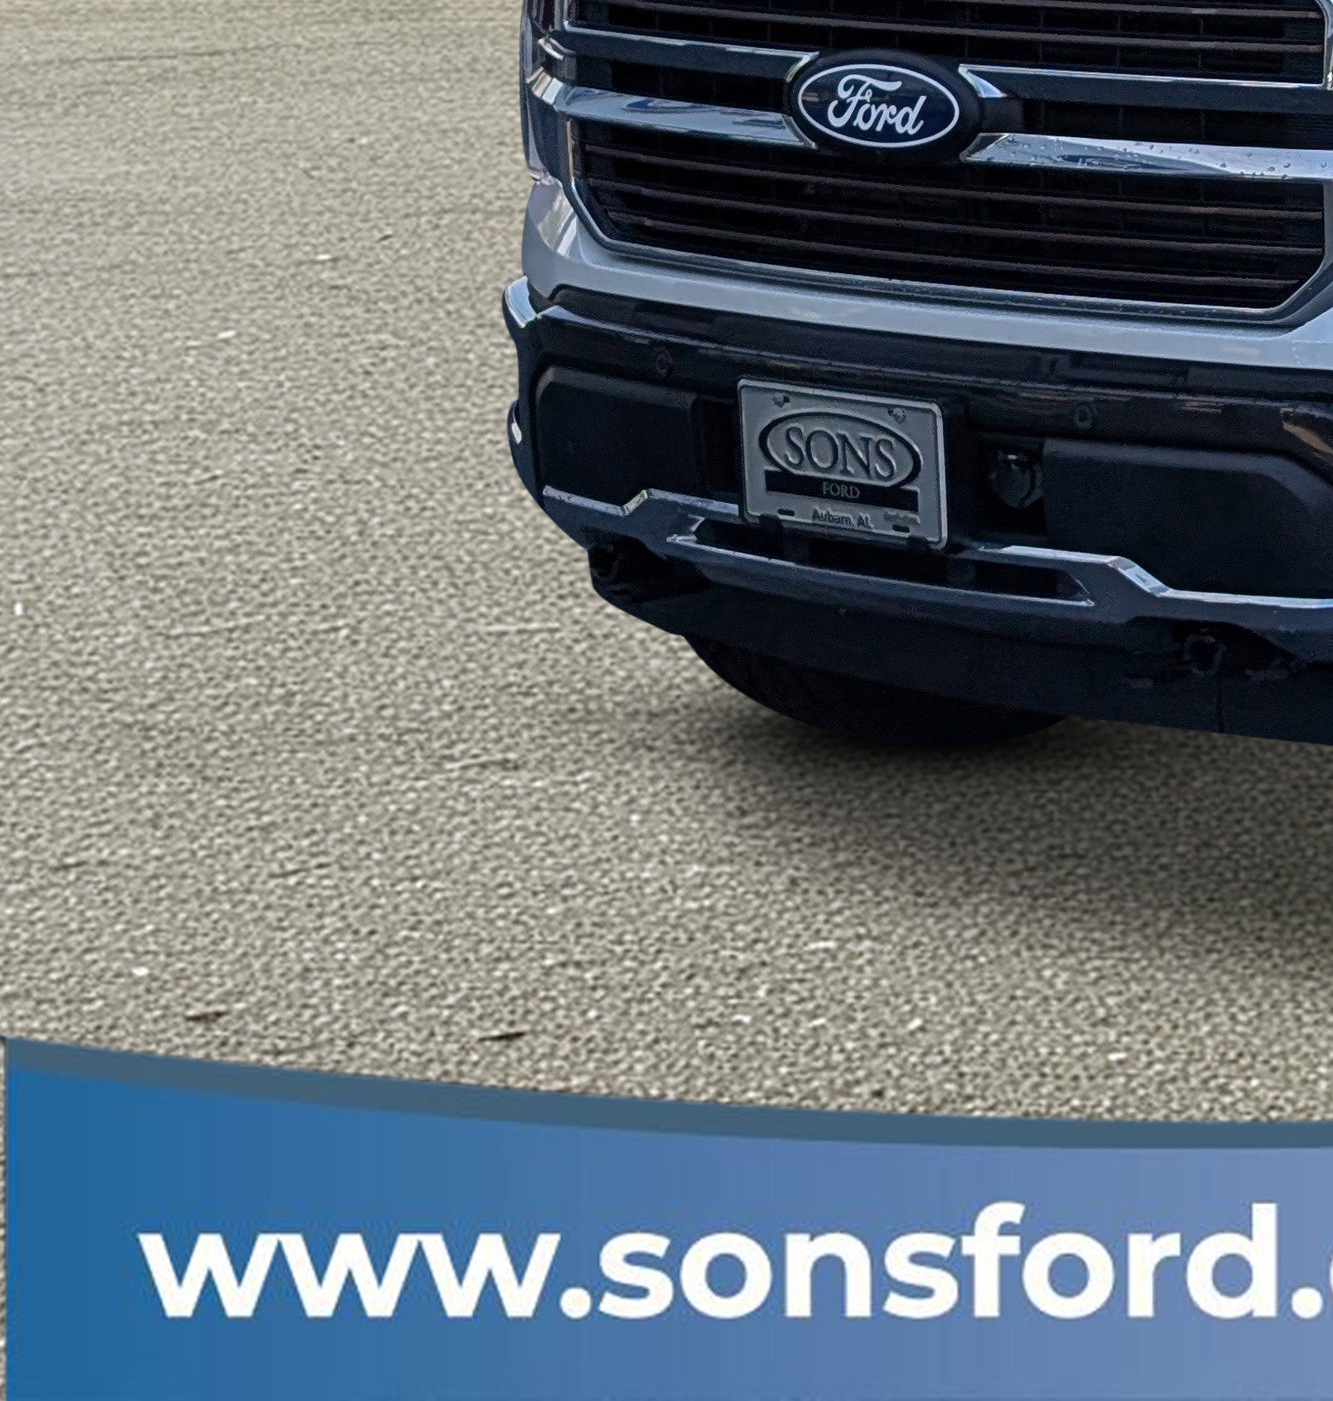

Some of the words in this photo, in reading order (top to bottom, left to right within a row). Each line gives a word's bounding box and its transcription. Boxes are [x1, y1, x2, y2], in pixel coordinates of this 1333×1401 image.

[827, 73, 928, 136] Ford
[784, 425, 898, 484] SONS
[822, 480, 861, 499] FORD
